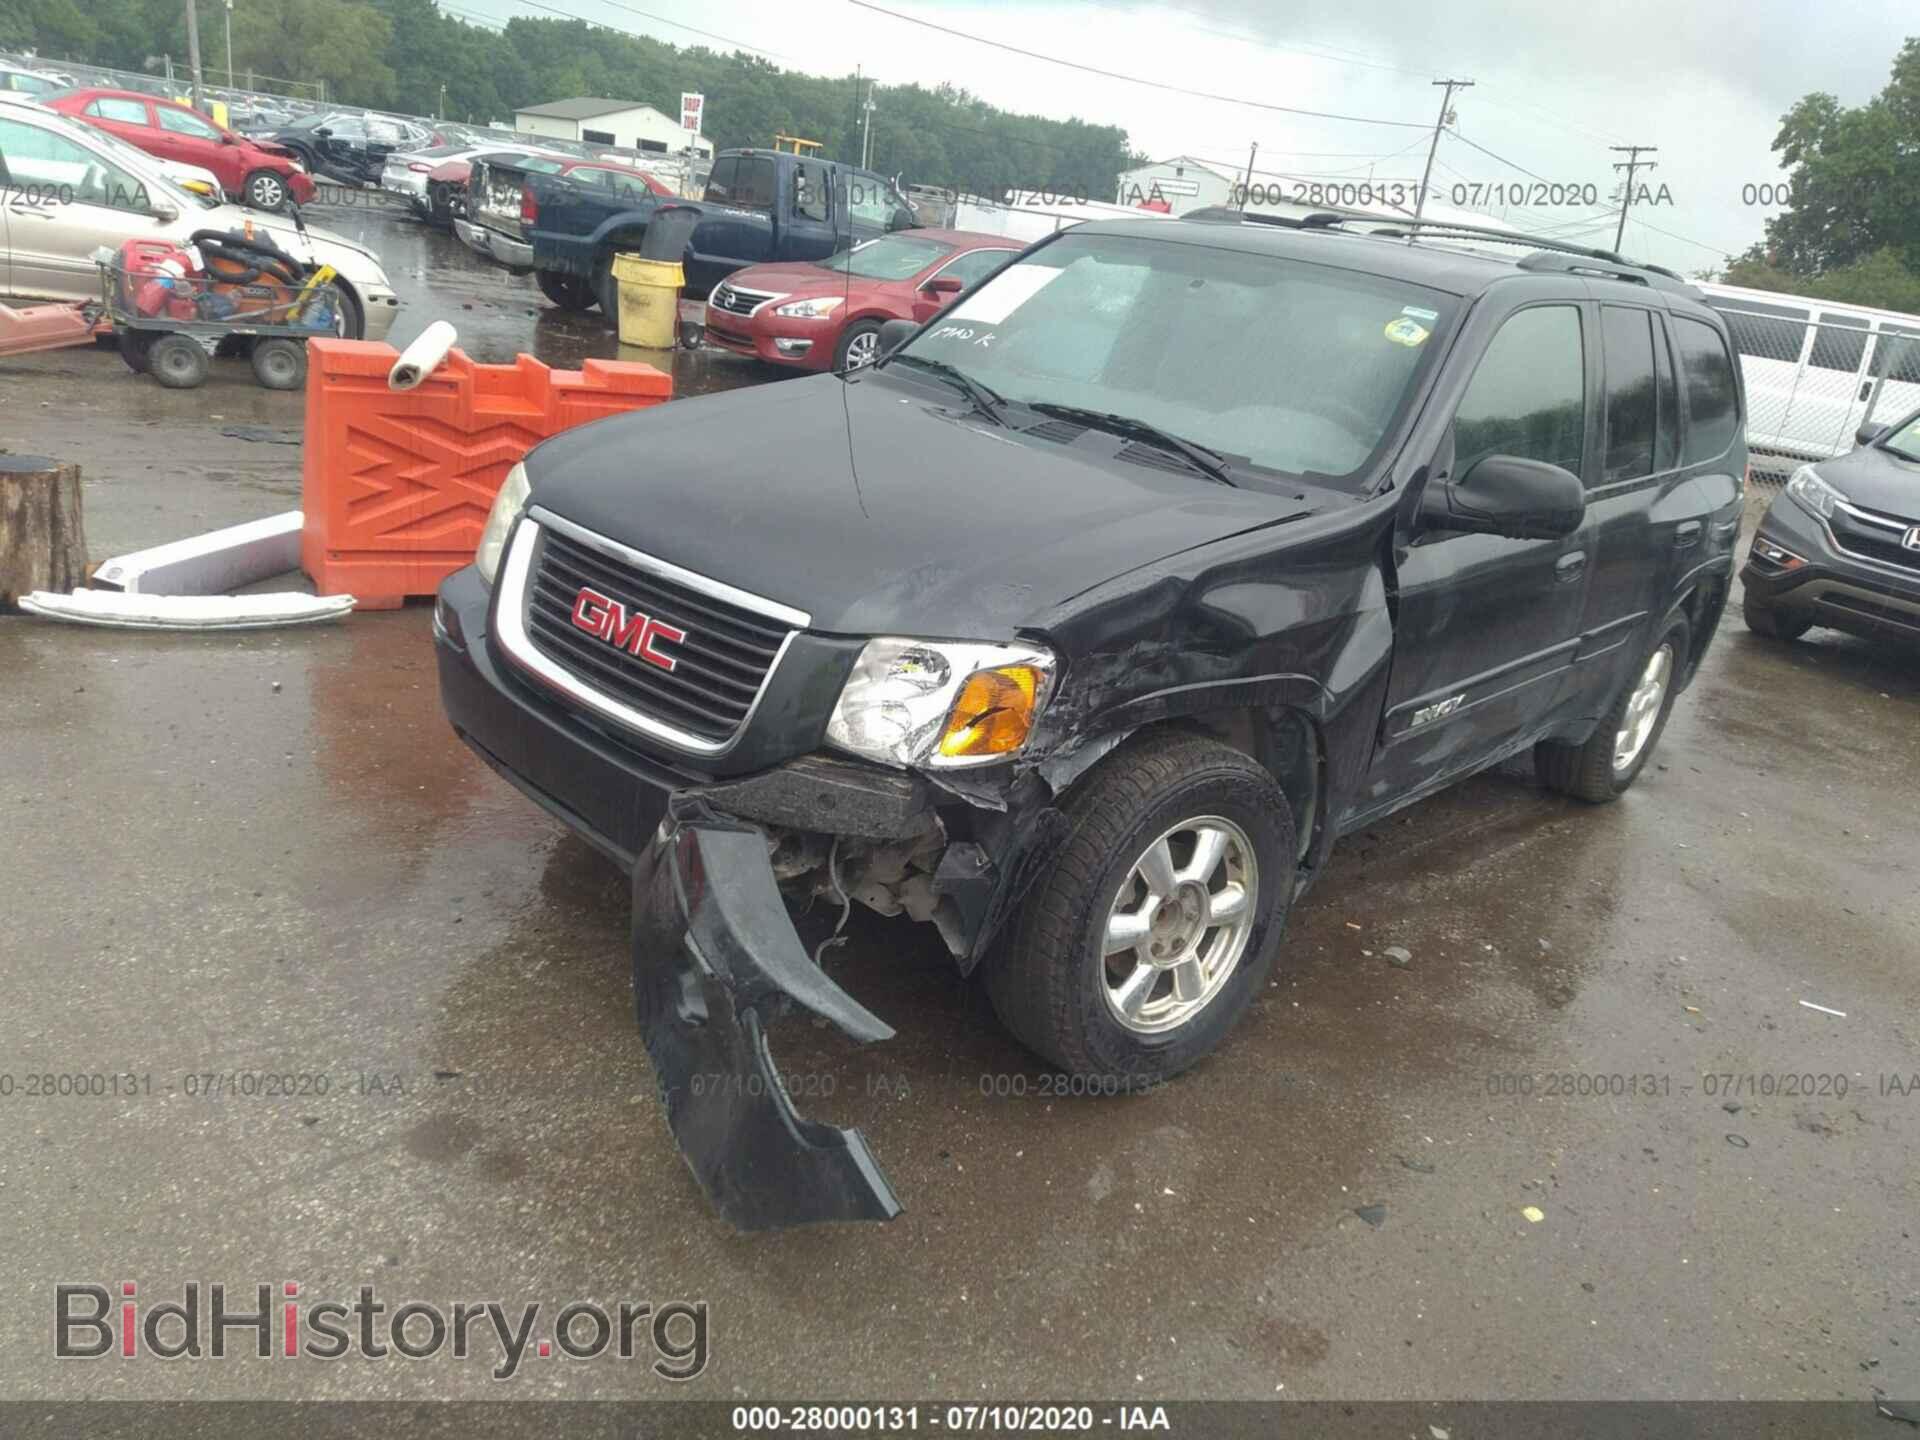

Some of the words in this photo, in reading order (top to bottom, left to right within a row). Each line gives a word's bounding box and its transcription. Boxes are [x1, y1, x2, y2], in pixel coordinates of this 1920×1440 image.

[683, 97, 701, 112] DROP
[683, 115, 698, 130] ZONE
[571, 586, 687, 672] GMC
